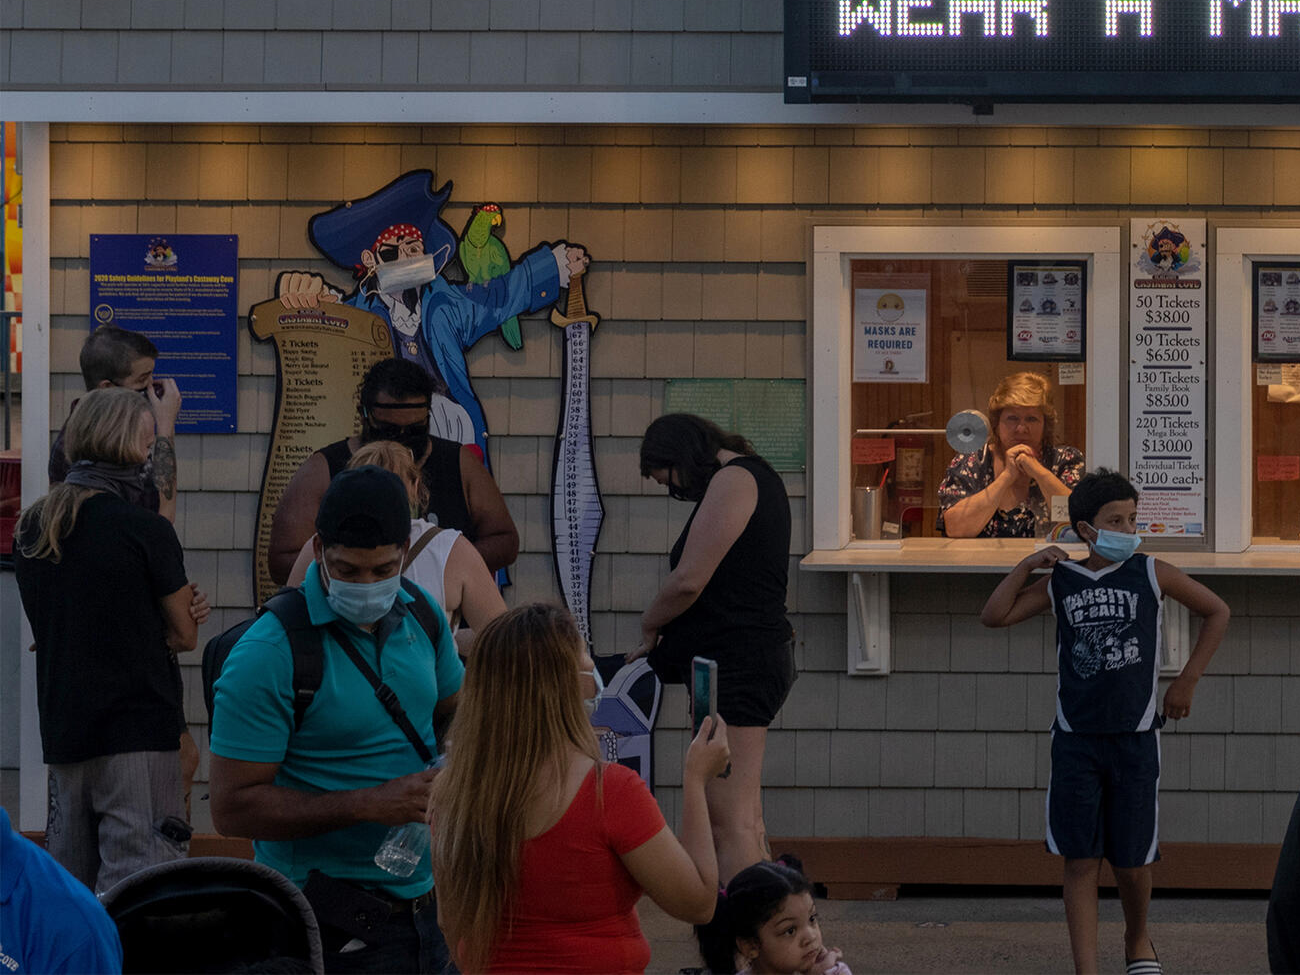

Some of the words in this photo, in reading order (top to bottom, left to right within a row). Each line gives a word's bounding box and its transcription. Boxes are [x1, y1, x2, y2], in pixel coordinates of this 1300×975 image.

[1136, 295, 1153, 308] 50
[1156, 294, 1200, 308] Tickets
[1145, 309, 1190, 323] $38.00
[864, 326, 896, 336] MASKS
[899, 326, 916, 336] ARE
[868, 340, 913, 349] REQUIRED
[1136, 334, 1152, 346] 90
[1156, 333, 1200, 346] Tickets
[1145, 348, 1189, 362] $65.00
[294, 378, 323, 386] Tickets
[1137, 372, 1156, 383] 130
[1160, 371, 1200, 384] Tickets
[1145, 384, 1169, 392] Family
[1172, 384, 1190, 392] Book
[1146, 393, 1189, 407] $85.00
[1136, 417, 1157, 429] 220
[1160, 416, 1200, 429] Tickets
[1147, 430, 1167, 438] Mega
[1169, 429, 1188, 437] Book
[1142, 439, 1193, 452] $130.00
[1135, 461, 1175, 470] Individual
[1177, 461, 1200, 470] Ticket
[1136, 472, 1168, 484] $1.00
[1172, 472, 1199, 484] each
[1062, 587, 1139, 626] VARSITY
[1105, 636, 1139, 662] 36
[1105, 656, 1142, 671] Captain
